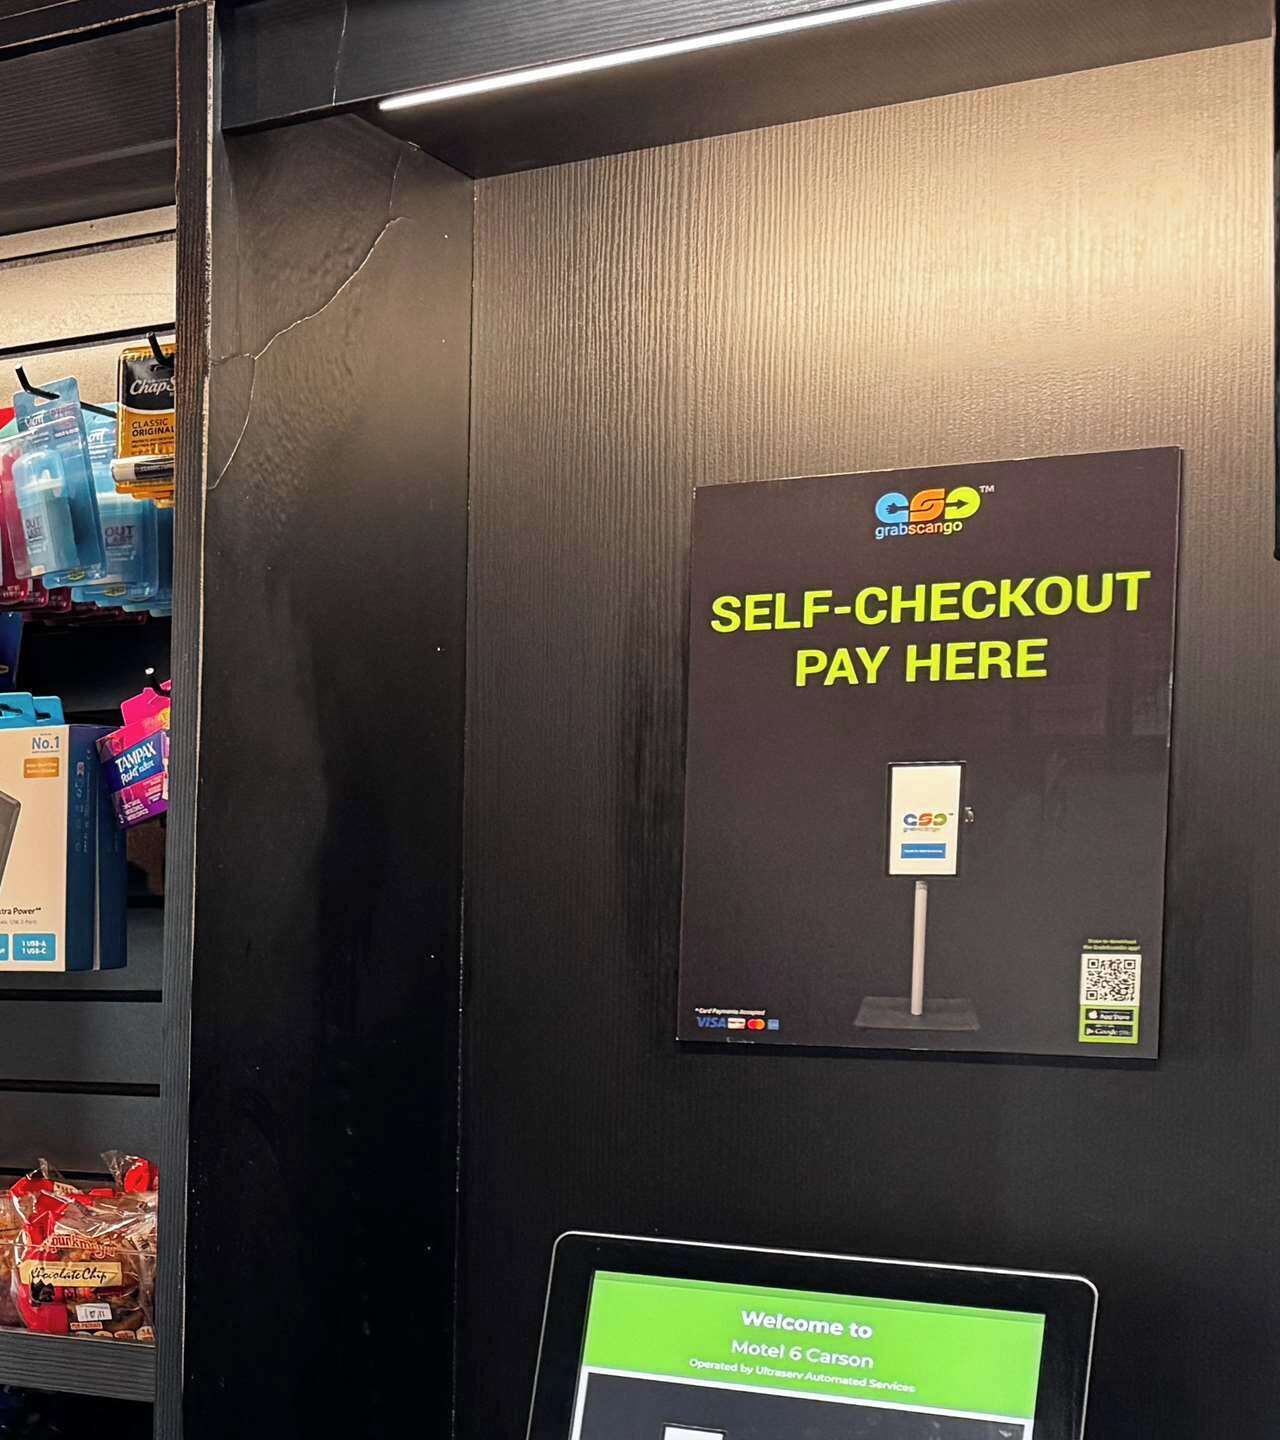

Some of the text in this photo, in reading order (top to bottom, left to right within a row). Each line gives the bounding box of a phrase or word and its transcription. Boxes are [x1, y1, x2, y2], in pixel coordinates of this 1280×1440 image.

[132, 418, 169, 430] CLASSIC
[876, 520, 964, 541] grabscango
[711, 571, 1151, 633] SELF-CHECKOUT
[795, 638, 1048, 687] PAY HERE
[32, 736, 62, 752] No.1
[114, 740, 157, 775] TAMPAX
[698, 1018, 727, 1029] VISA
[32, 1267, 109, 1285] Chocolate Chip
[742, 1312, 874, 1340] Welcome to
[732, 1340, 875, 1370] Motel 6 Carson
[690, 1359, 917, 1394] Operated by Ultraserv Automated Services
